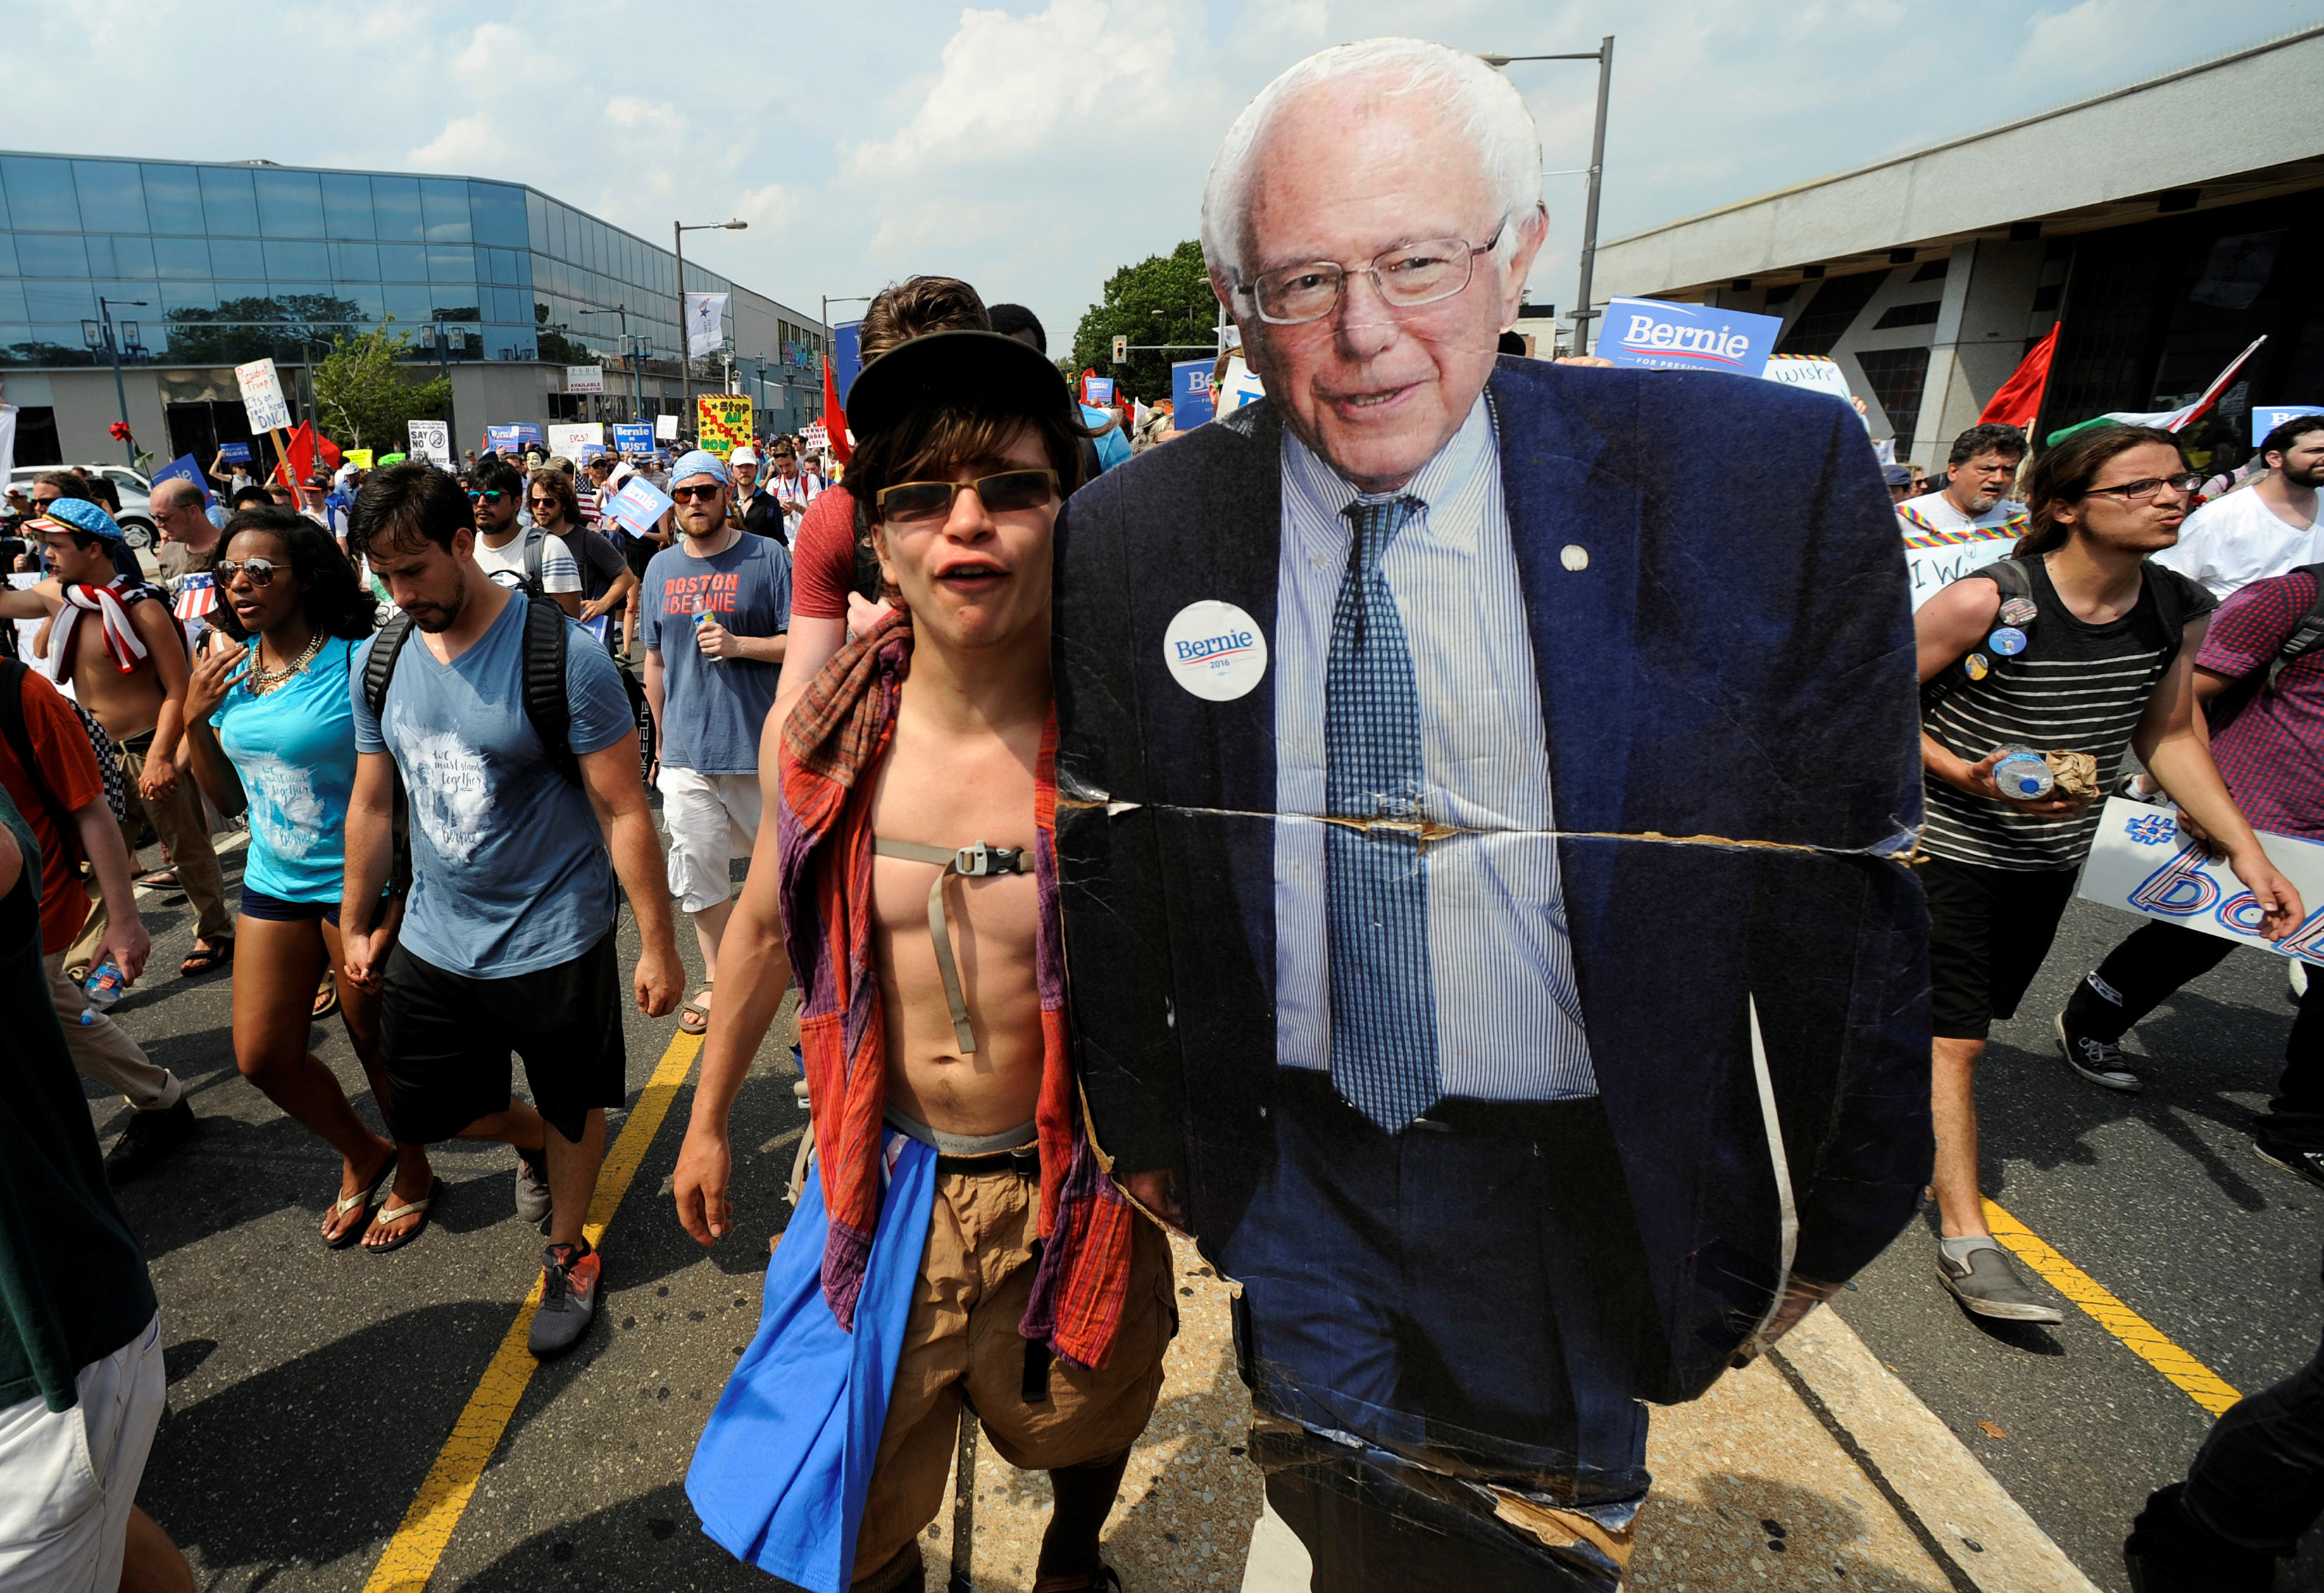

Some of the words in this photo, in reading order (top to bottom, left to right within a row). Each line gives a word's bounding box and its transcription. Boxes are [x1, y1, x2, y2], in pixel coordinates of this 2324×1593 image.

[1623, 314, 1750, 358] Bernie
[1636, 357, 1657, 366] FOR
[237, 361, 269, 385] President
[263, 394, 273, 402] on
[268, 396, 285, 411] head
[258, 409, 287, 430] DNC!
[411, 430, 427, 439] SAY
[616, 426, 649, 436] Bernie
[412, 439, 425, 449] NO
[620, 442, 647, 451] BUST
[701, 439, 730, 451] NOW
[1911, 559, 1926, 589] I
[665, 573, 739, 596] BOSTON
[1175, 629, 1254, 660] Bernie
[1209, 658, 1230, 669] 2016
[434, 758, 458, 770] must
[461, 761, 482, 773] stand
[442, 770, 482, 793] together
[272, 785, 308, 804] together
